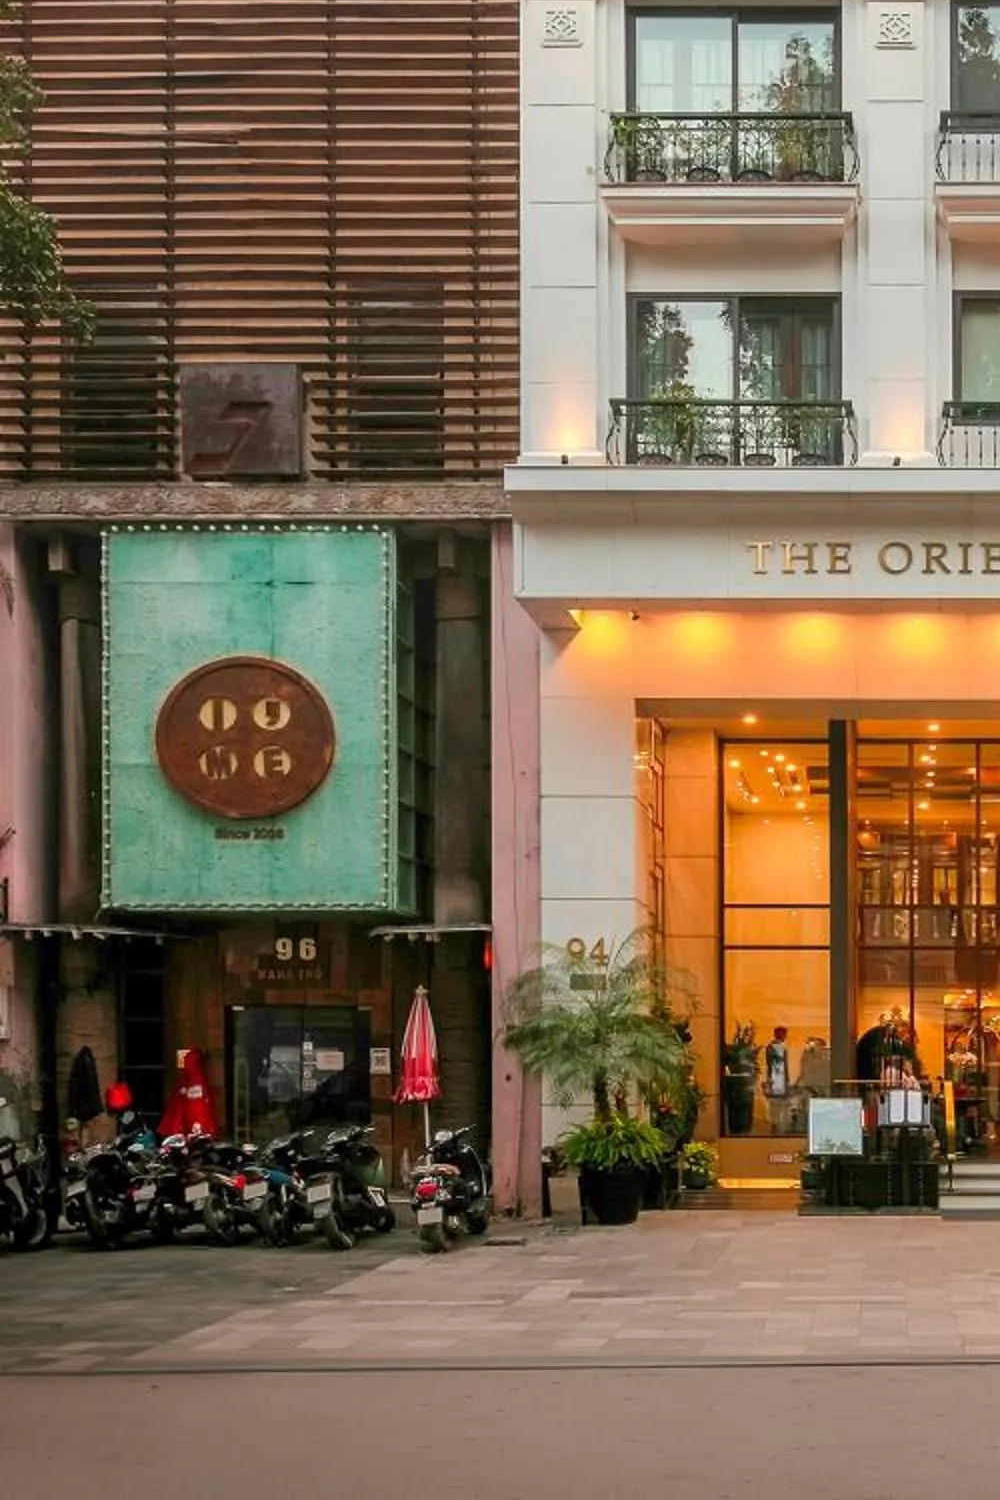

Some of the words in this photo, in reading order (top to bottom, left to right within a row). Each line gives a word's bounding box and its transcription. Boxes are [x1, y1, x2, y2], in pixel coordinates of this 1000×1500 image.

[748, 542, 851, 575] THE
[275, 937, 317, 961] 96
[566, 937, 609, 968] 94
